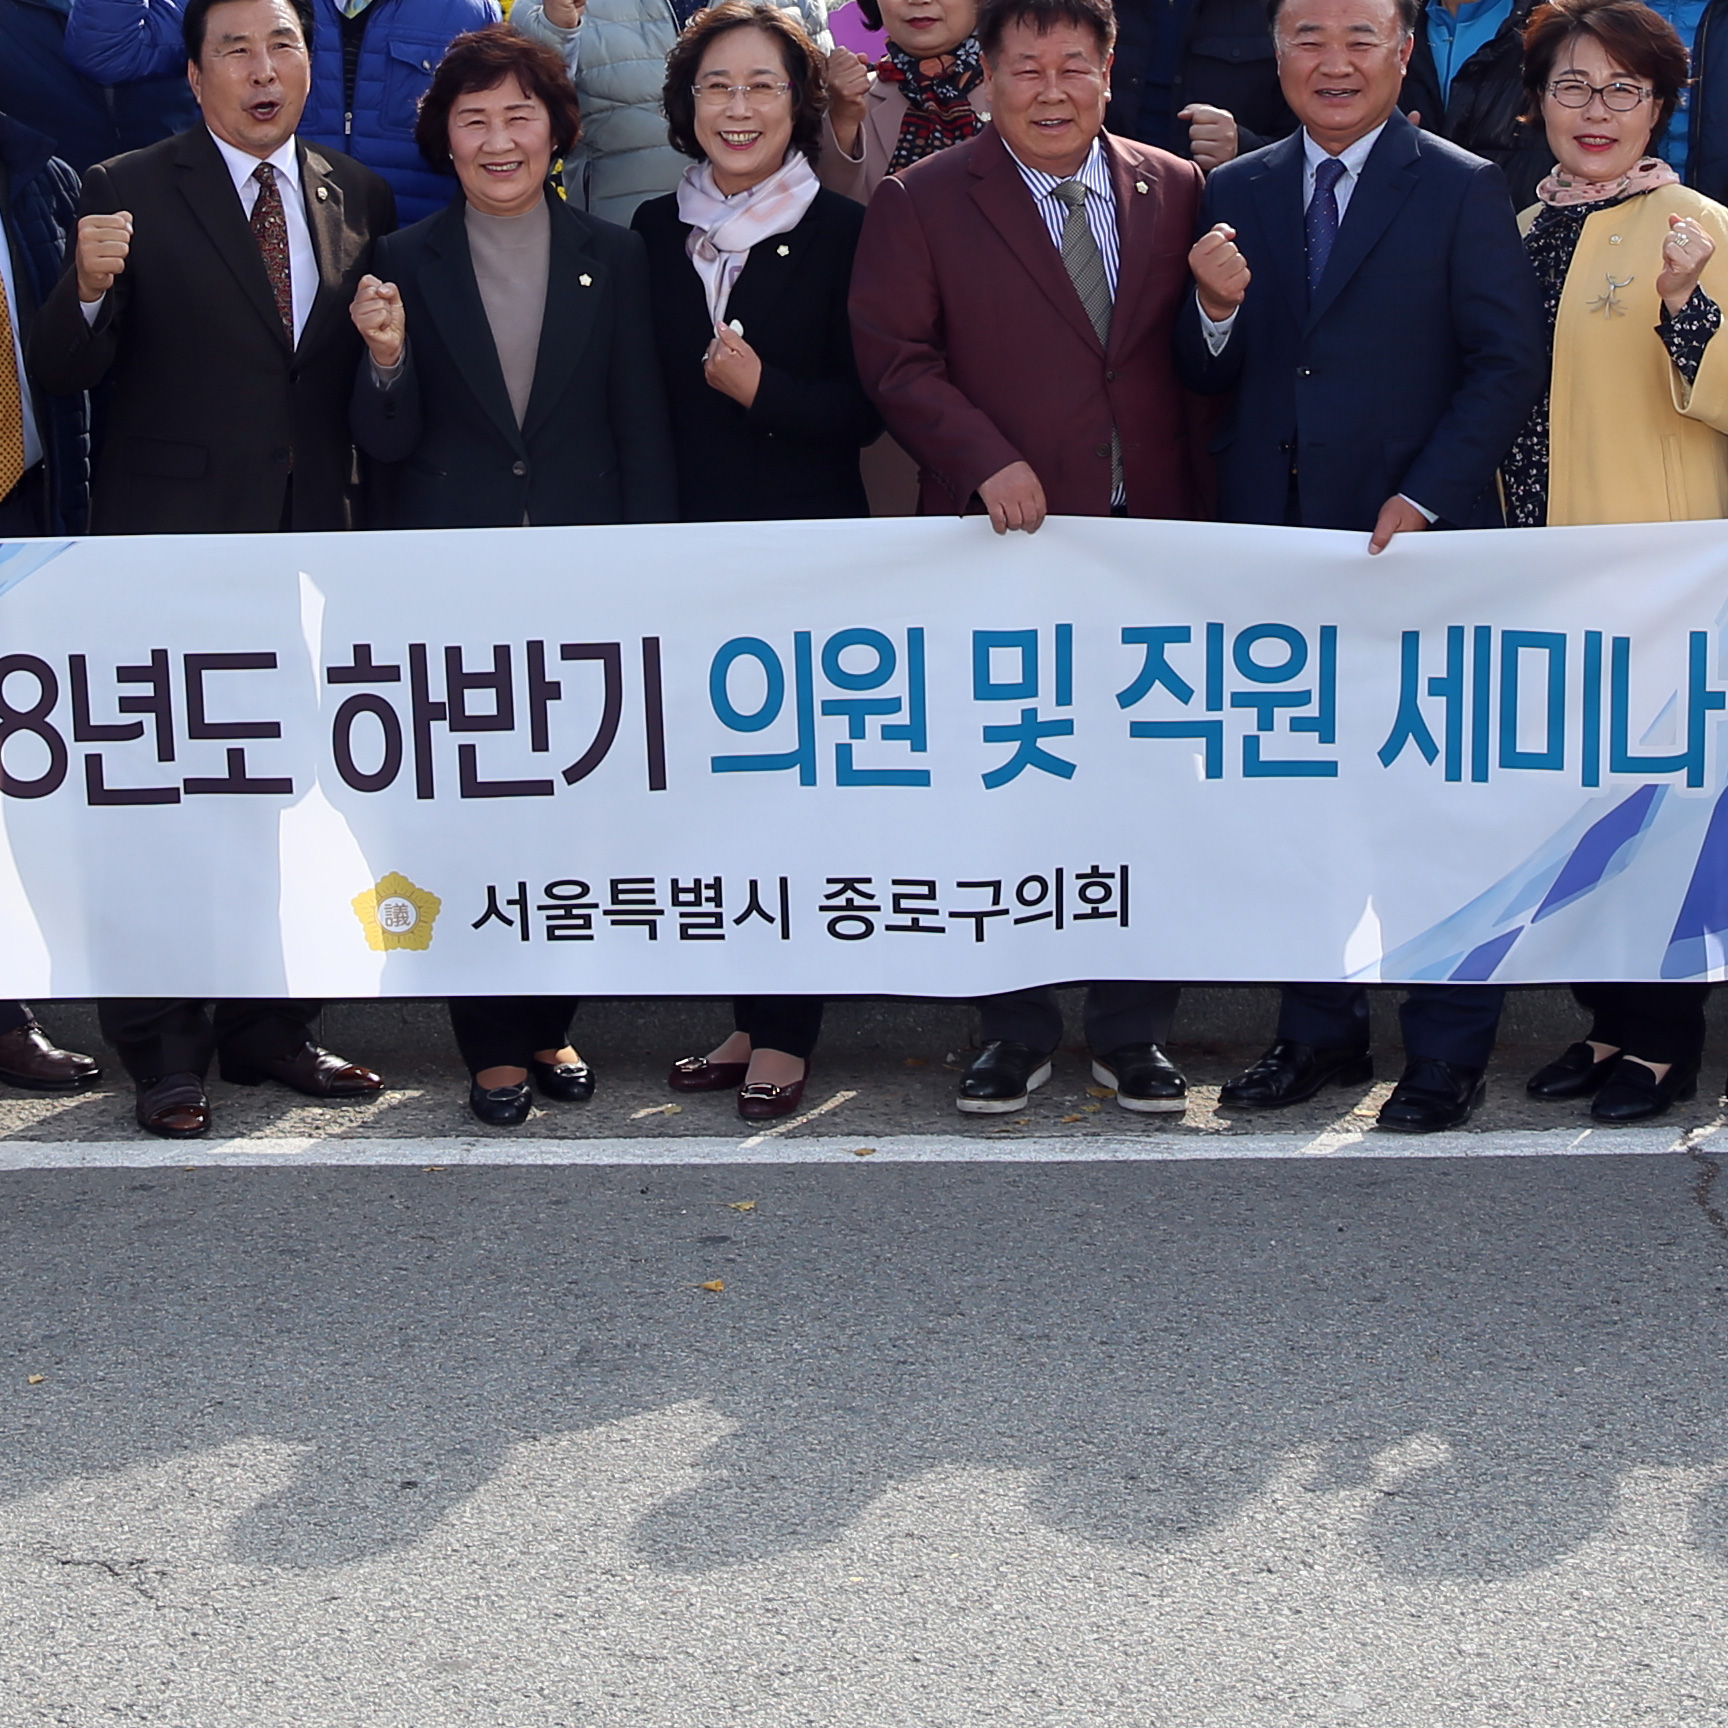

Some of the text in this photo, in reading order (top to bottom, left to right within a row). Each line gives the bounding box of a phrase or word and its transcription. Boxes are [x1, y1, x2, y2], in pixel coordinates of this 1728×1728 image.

[326, 636, 668, 800] 하반기
[708, 624, 932, 788] 의원
[971, 622, 1078, 791] 및
[1114, 621, 1340, 783] 직원
[1375, 623, 1727, 790] 세미나
[384, 903, 411, 927] 議
[471, 863, 1131, 943] 서울특별시 종로구의회
